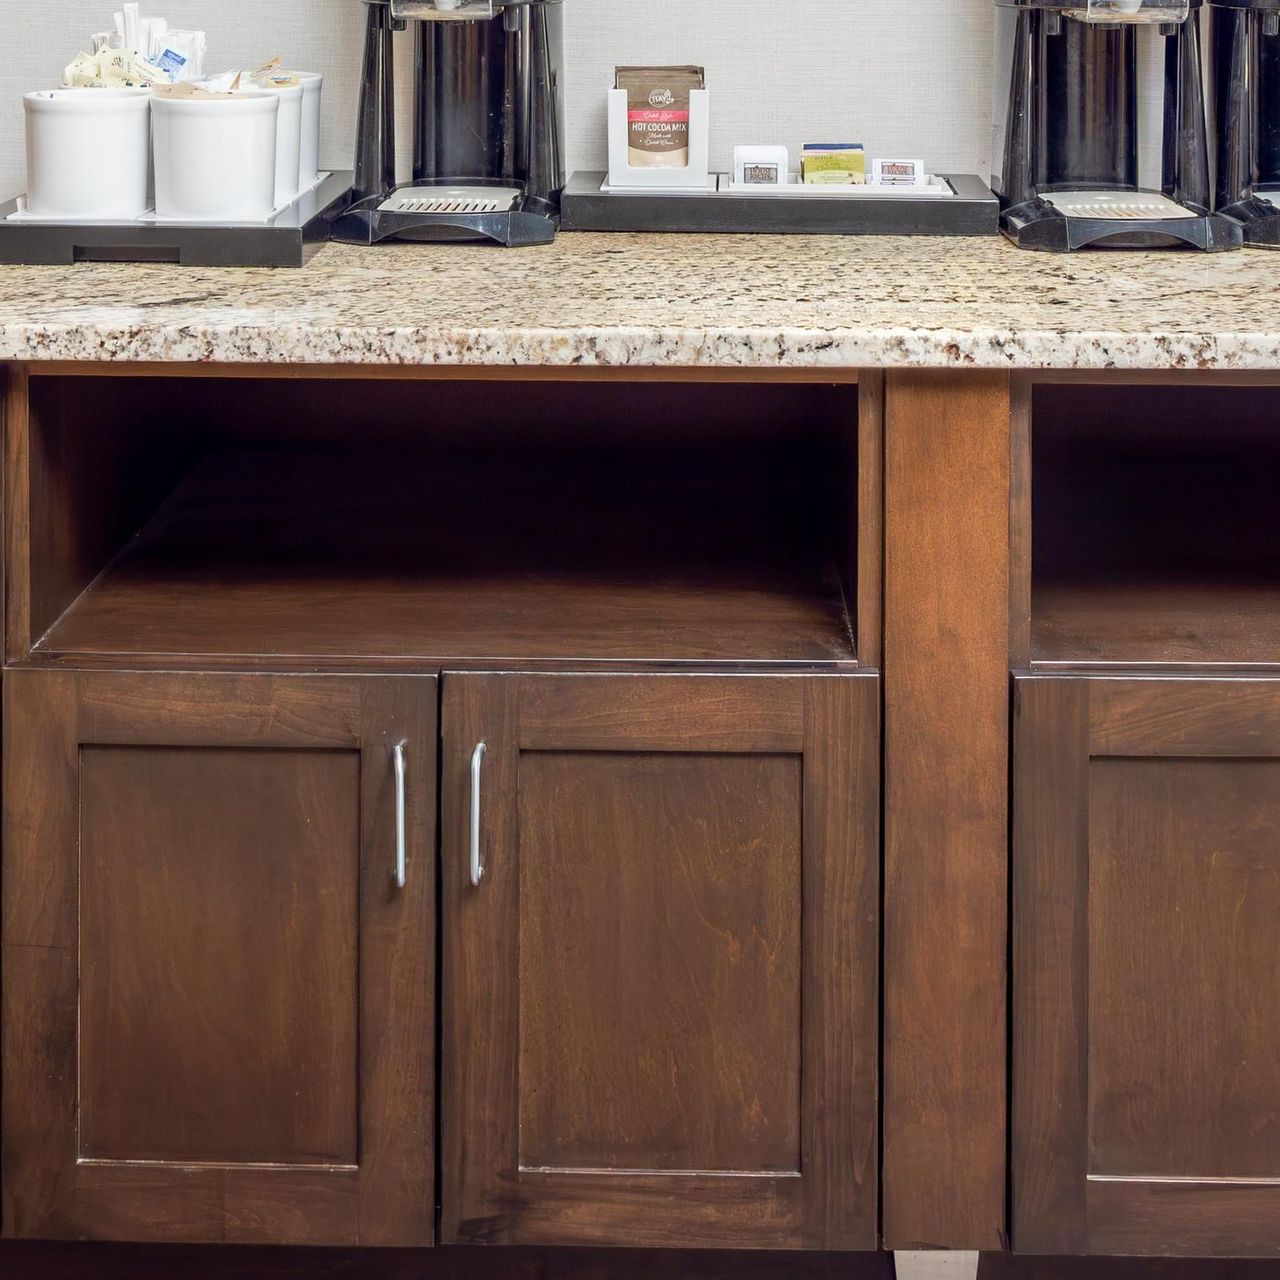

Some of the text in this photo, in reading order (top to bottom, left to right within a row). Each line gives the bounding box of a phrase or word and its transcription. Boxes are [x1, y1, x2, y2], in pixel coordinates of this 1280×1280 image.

[632, 122, 687, 131] HOT COCOA MIX
